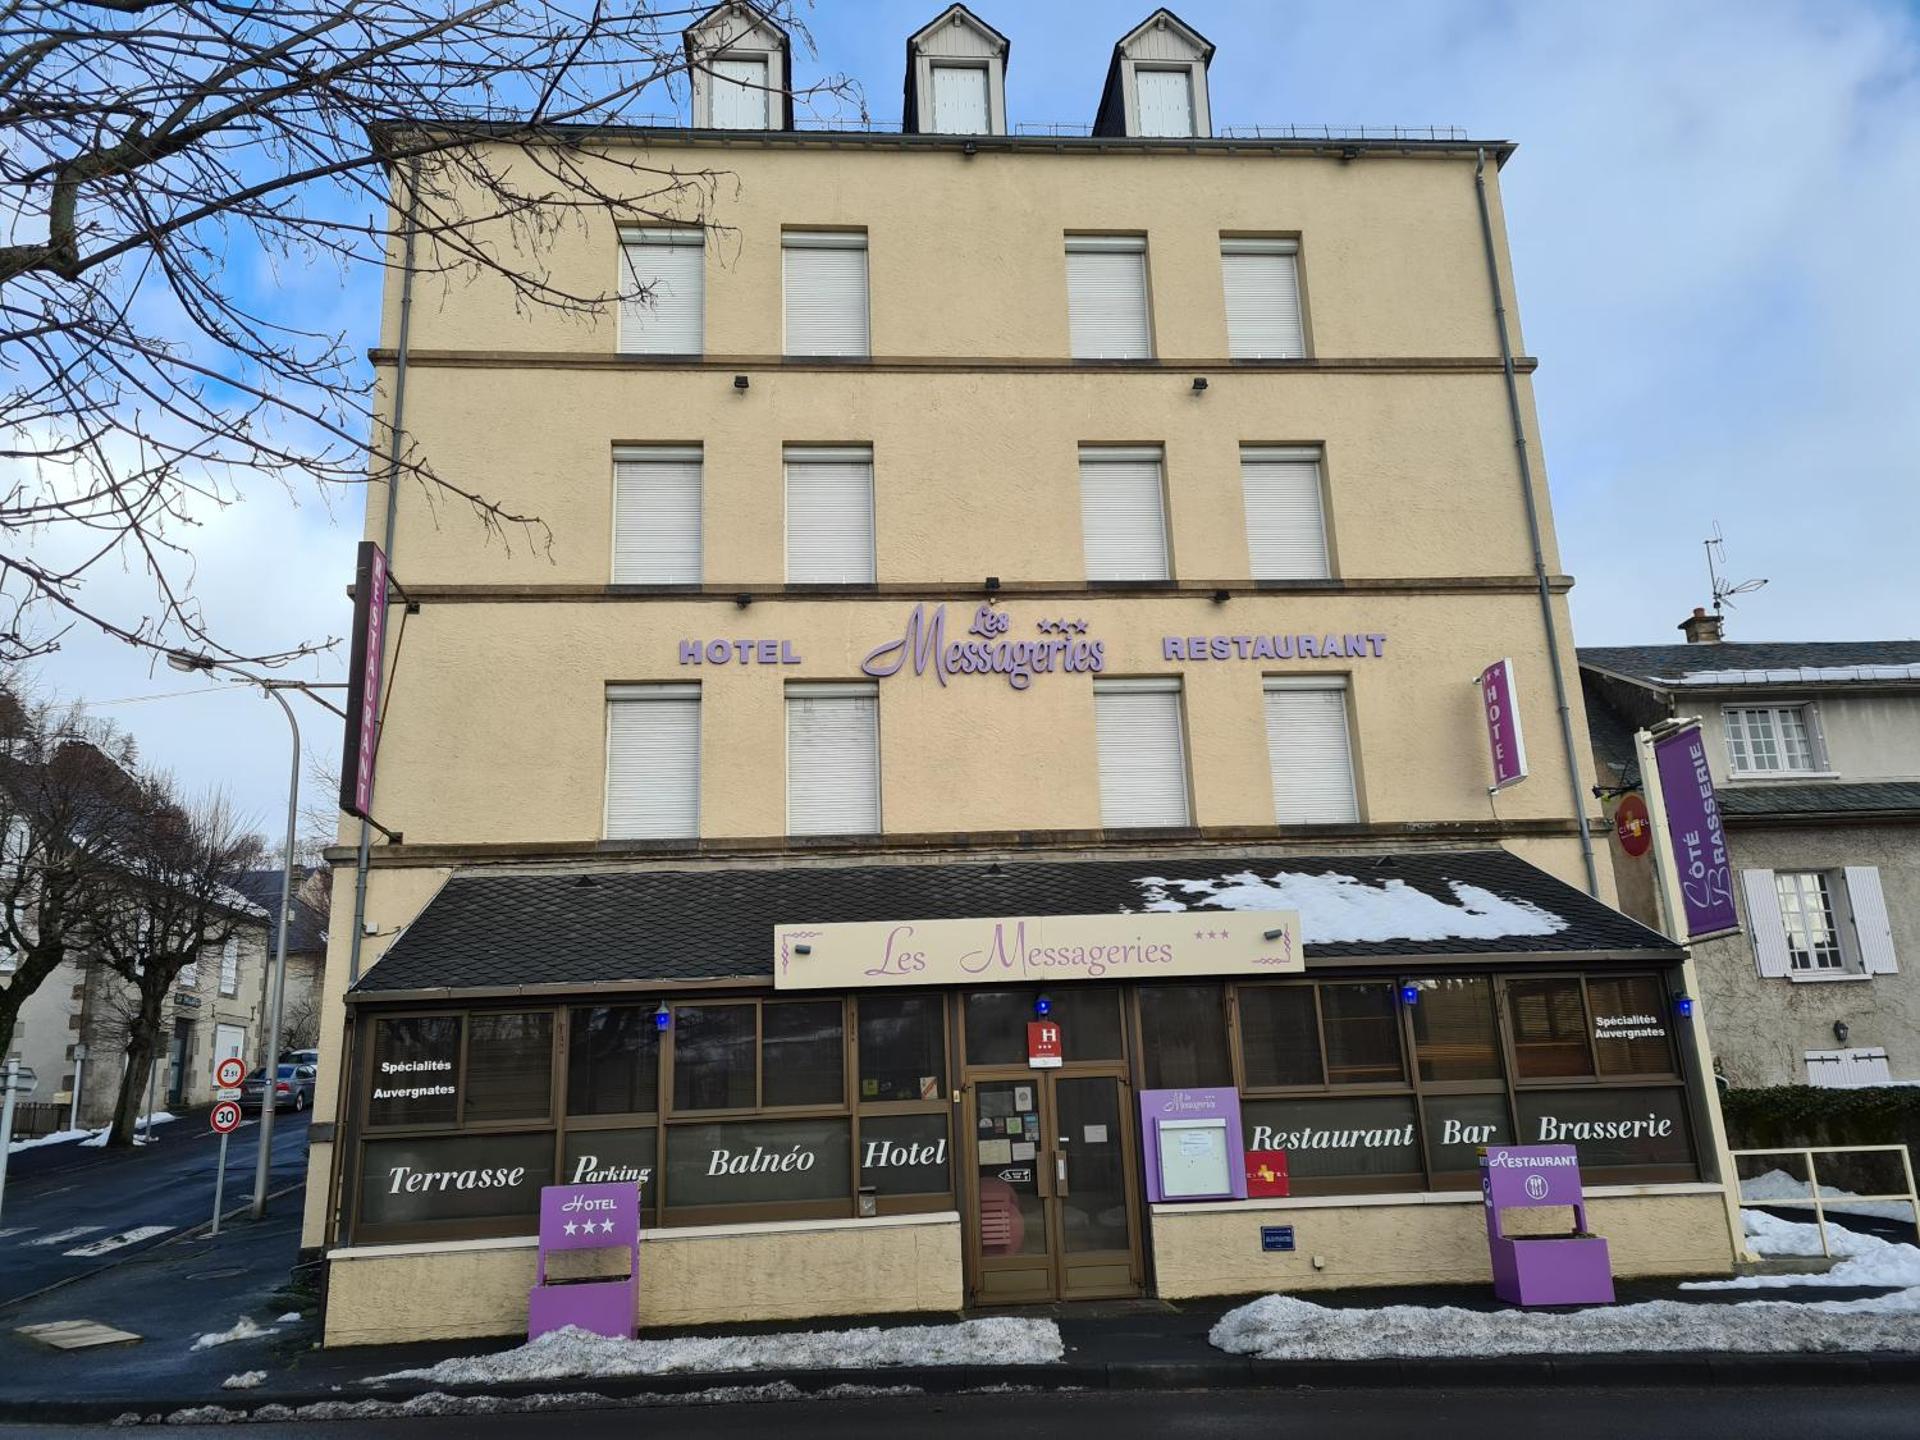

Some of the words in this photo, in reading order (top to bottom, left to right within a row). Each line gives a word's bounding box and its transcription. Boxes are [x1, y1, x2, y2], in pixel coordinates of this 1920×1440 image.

[969, 604, 1009, 638] Les
[679, 639, 801, 664] HOTEL
[861, 602, 1103, 690] Messageries
[1163, 633, 1387, 661] RESTAURANT
[360, 556, 382, 805] RESTAURANT
[1487, 685, 1507, 779] HOTEL
[1689, 743, 1734, 908] BRASSERIE
[864, 926, 926, 976] Les
[959, 921, 1173, 976] Messageries
[1042, 1028, 1057, 1042] H
[1596, 1015, 1656, 1027] Spécialités
[1596, 1026, 1665, 1039] Auvergnates
[381, 1060, 451, 1074] Spécialités
[374, 1083, 455, 1100] Auvergnates
[217, 1110, 234, 1124] 30
[1538, 1113, 1672, 1142] Brasserie
[1250, 1123, 1414, 1151] Restaurant
[1441, 1118, 1497, 1146] Bar
[706, 1144, 815, 1177] Balnéo
[862, 1138, 947, 1169] Hotel
[1489, 1151, 1578, 1168] RESTAURANT
[388, 1165, 525, 1195] Terrasse
[572, 1155, 651, 1183] Parking
[562, 1194, 618, 1213] HOTEL
